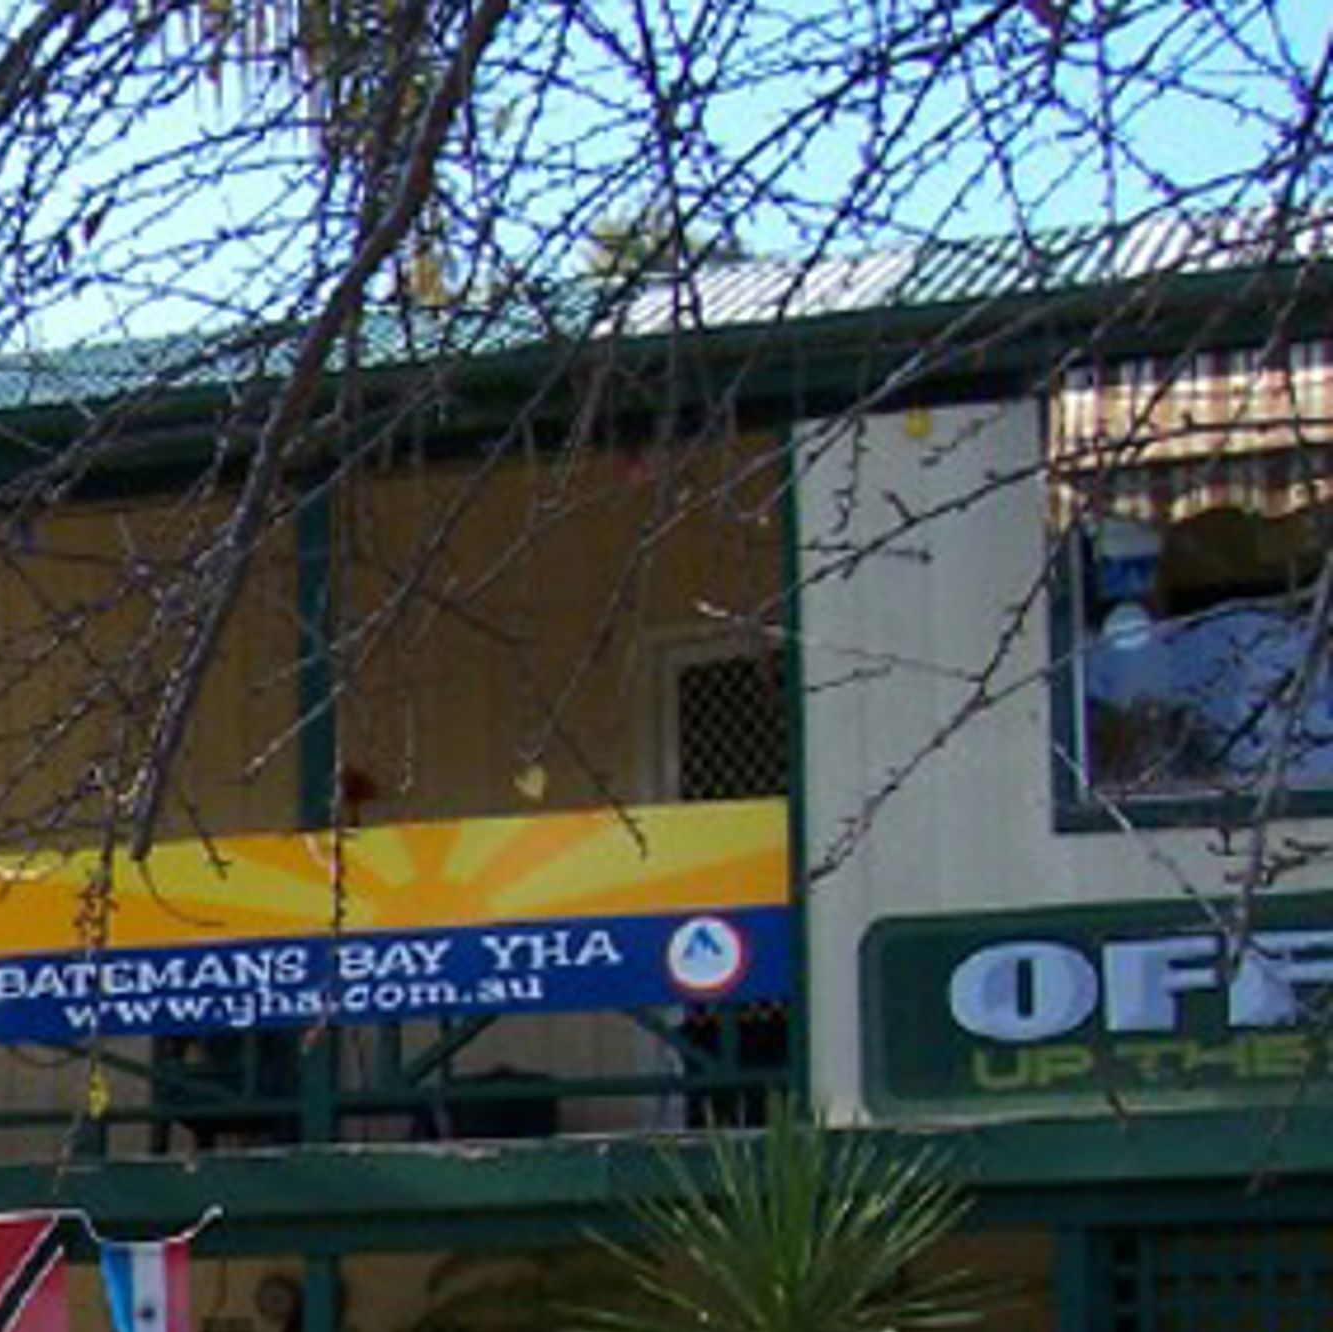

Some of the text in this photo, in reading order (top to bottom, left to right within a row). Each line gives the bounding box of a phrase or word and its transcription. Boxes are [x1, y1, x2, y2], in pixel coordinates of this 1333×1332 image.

[338, 940, 452, 980] BAY
[482, 929, 623, 971] YHA
[64, 976, 544, 1028] www.yha.com.au
[949, 930, 1333, 1041] OFF
[972, 1034, 1311, 1090] UP THE
